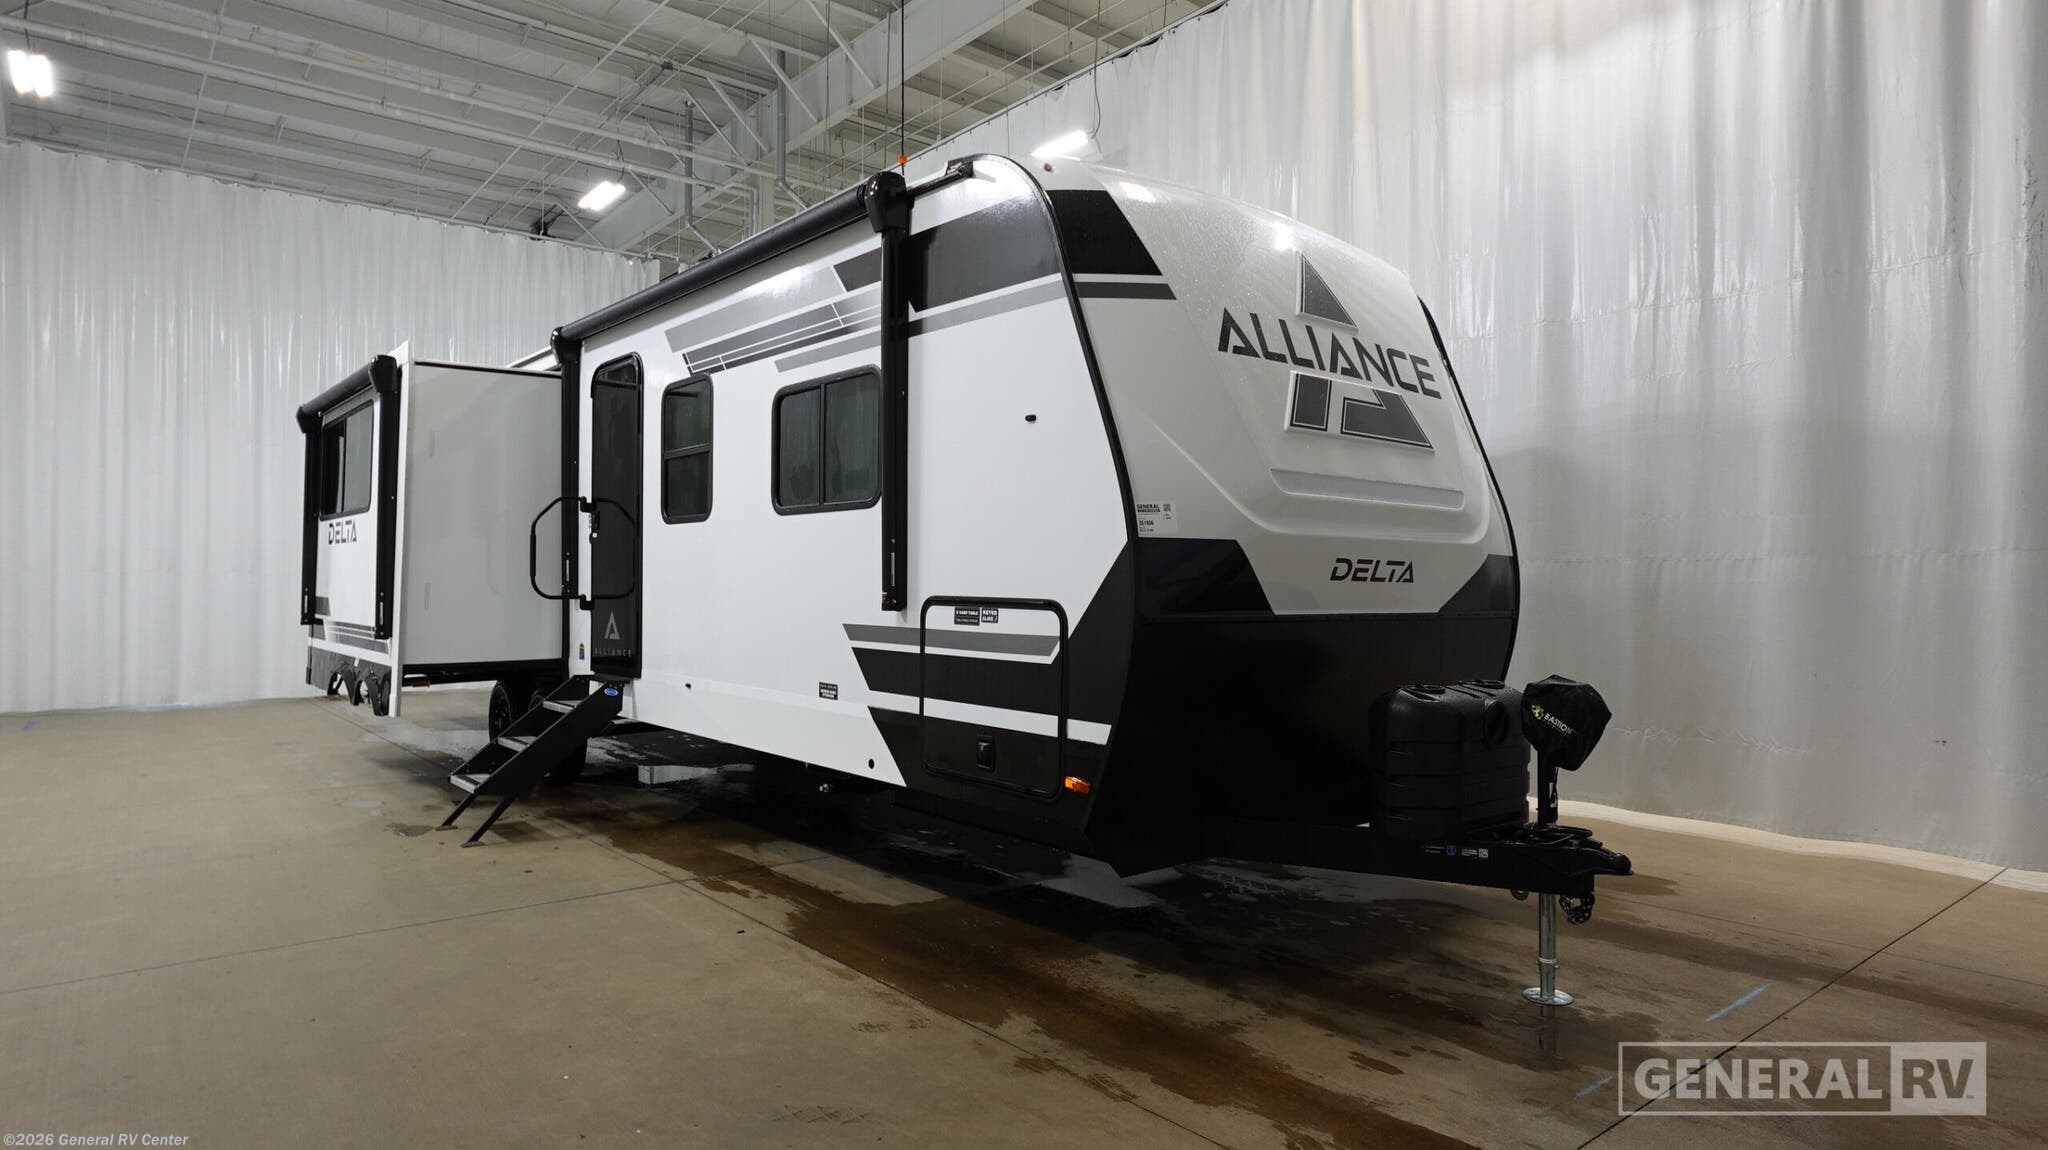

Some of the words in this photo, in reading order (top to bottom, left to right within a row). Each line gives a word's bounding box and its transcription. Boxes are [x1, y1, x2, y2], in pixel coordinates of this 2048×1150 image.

[1218, 308, 1442, 399] ALLIANCE
[328, 519, 357, 544] DELTA
[1330, 557, 1415, 583] DELTA
[593, 647, 633, 658] ALLIANCE
[1544, 712, 1573, 735] BASTION
